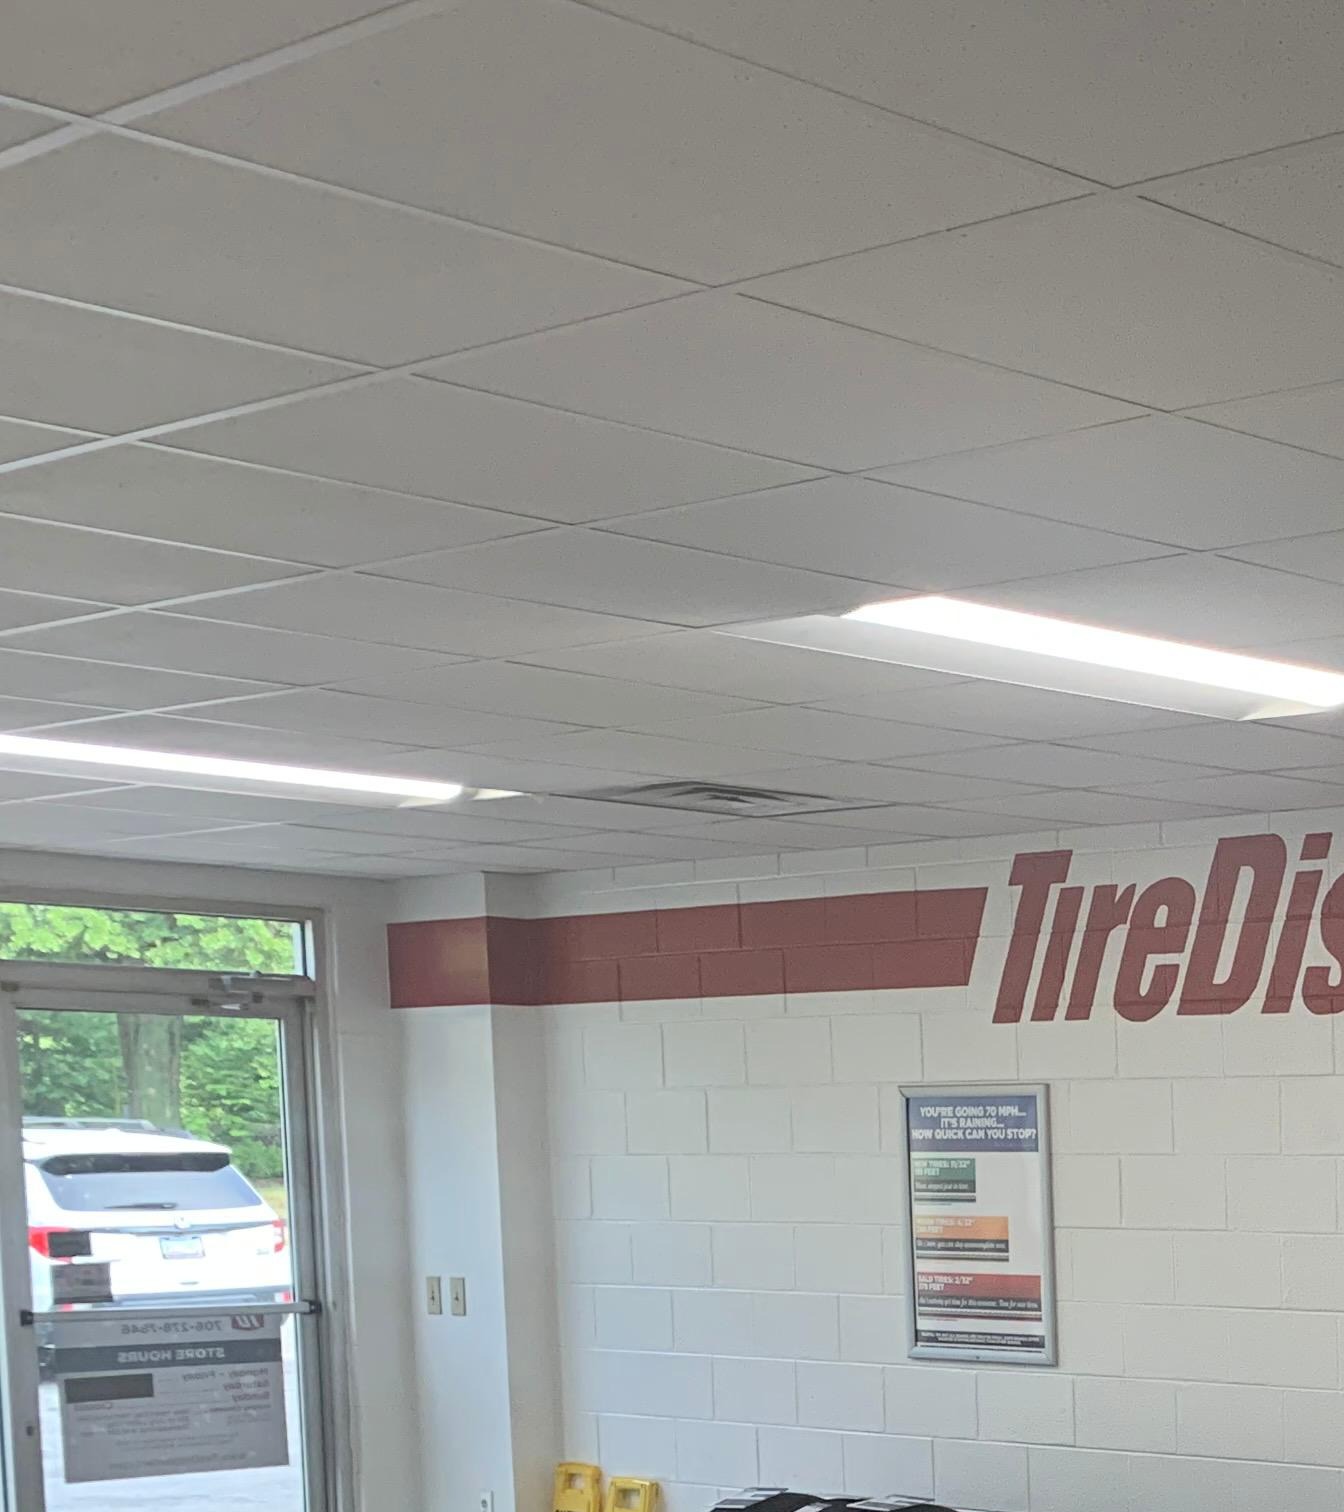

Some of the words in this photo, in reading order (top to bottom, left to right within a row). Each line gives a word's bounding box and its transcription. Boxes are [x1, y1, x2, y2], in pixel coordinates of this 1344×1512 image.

[920, 1106, 953, 1117] YOU'RE
[955, 1106, 984, 1117] GOING
[986, 1106, 997, 1117] 70
[940, 1117, 957, 1128] IT'S
[911, 1129, 933, 1140] HOW
[934, 1129, 964, 1140] QUICK
[965, 1129, 985, 1140] CAN
[986, 1129, 1006, 1140] YOU
[1007, 1129, 1037, 1140] STOP?
